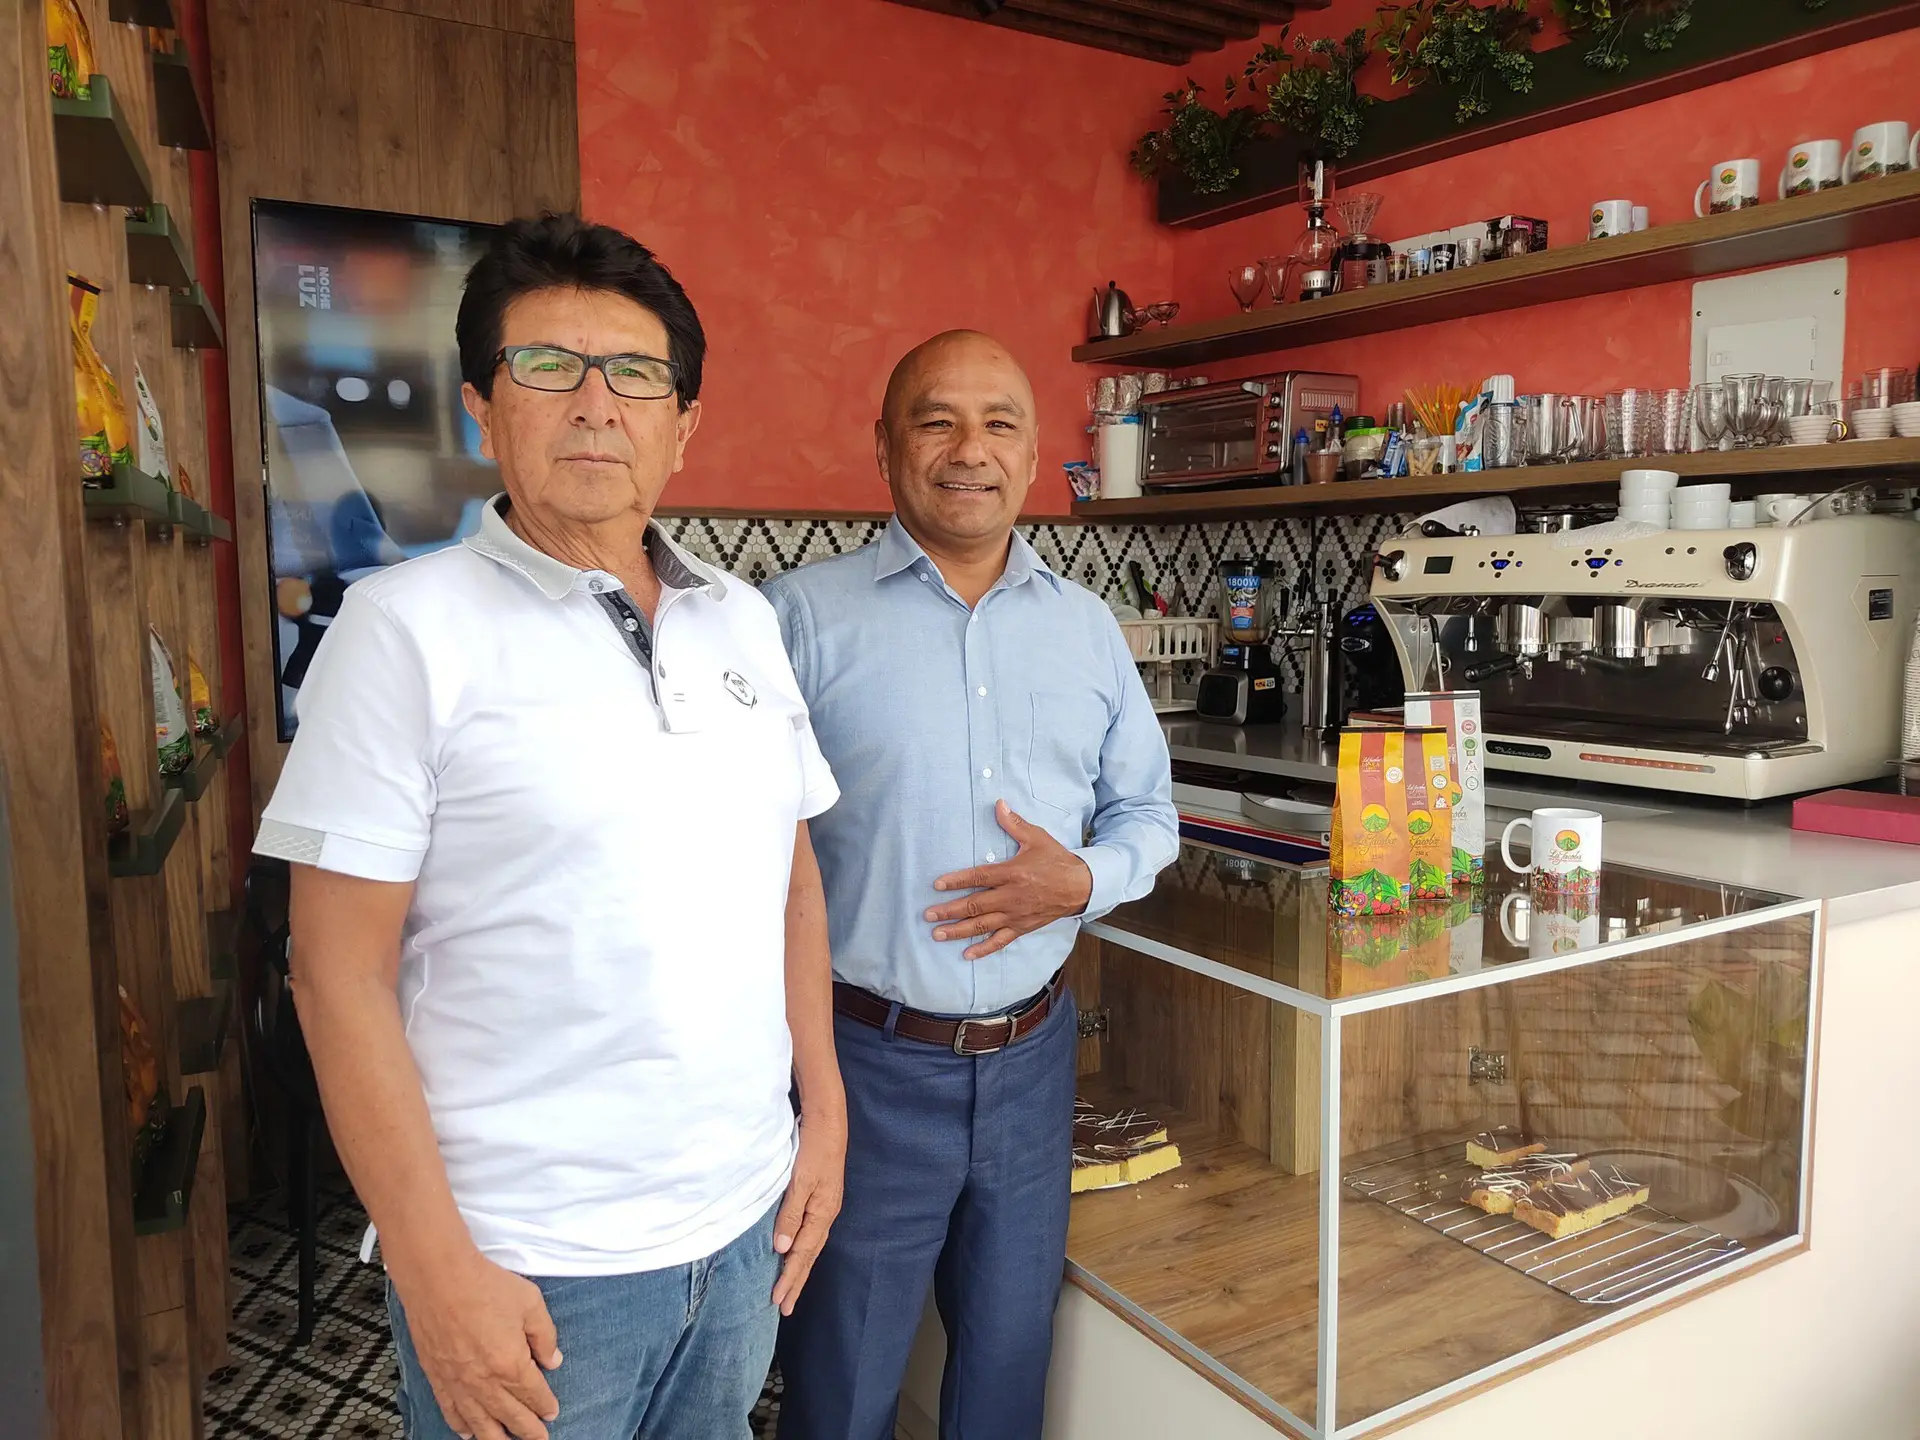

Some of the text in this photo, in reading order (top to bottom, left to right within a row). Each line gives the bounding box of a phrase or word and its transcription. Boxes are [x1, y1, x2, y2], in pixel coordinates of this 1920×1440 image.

[298, 265, 317, 308] LUZ
[319, 266, 331, 309] NOCHE
[1228, 577, 1259, 587] 1800W
